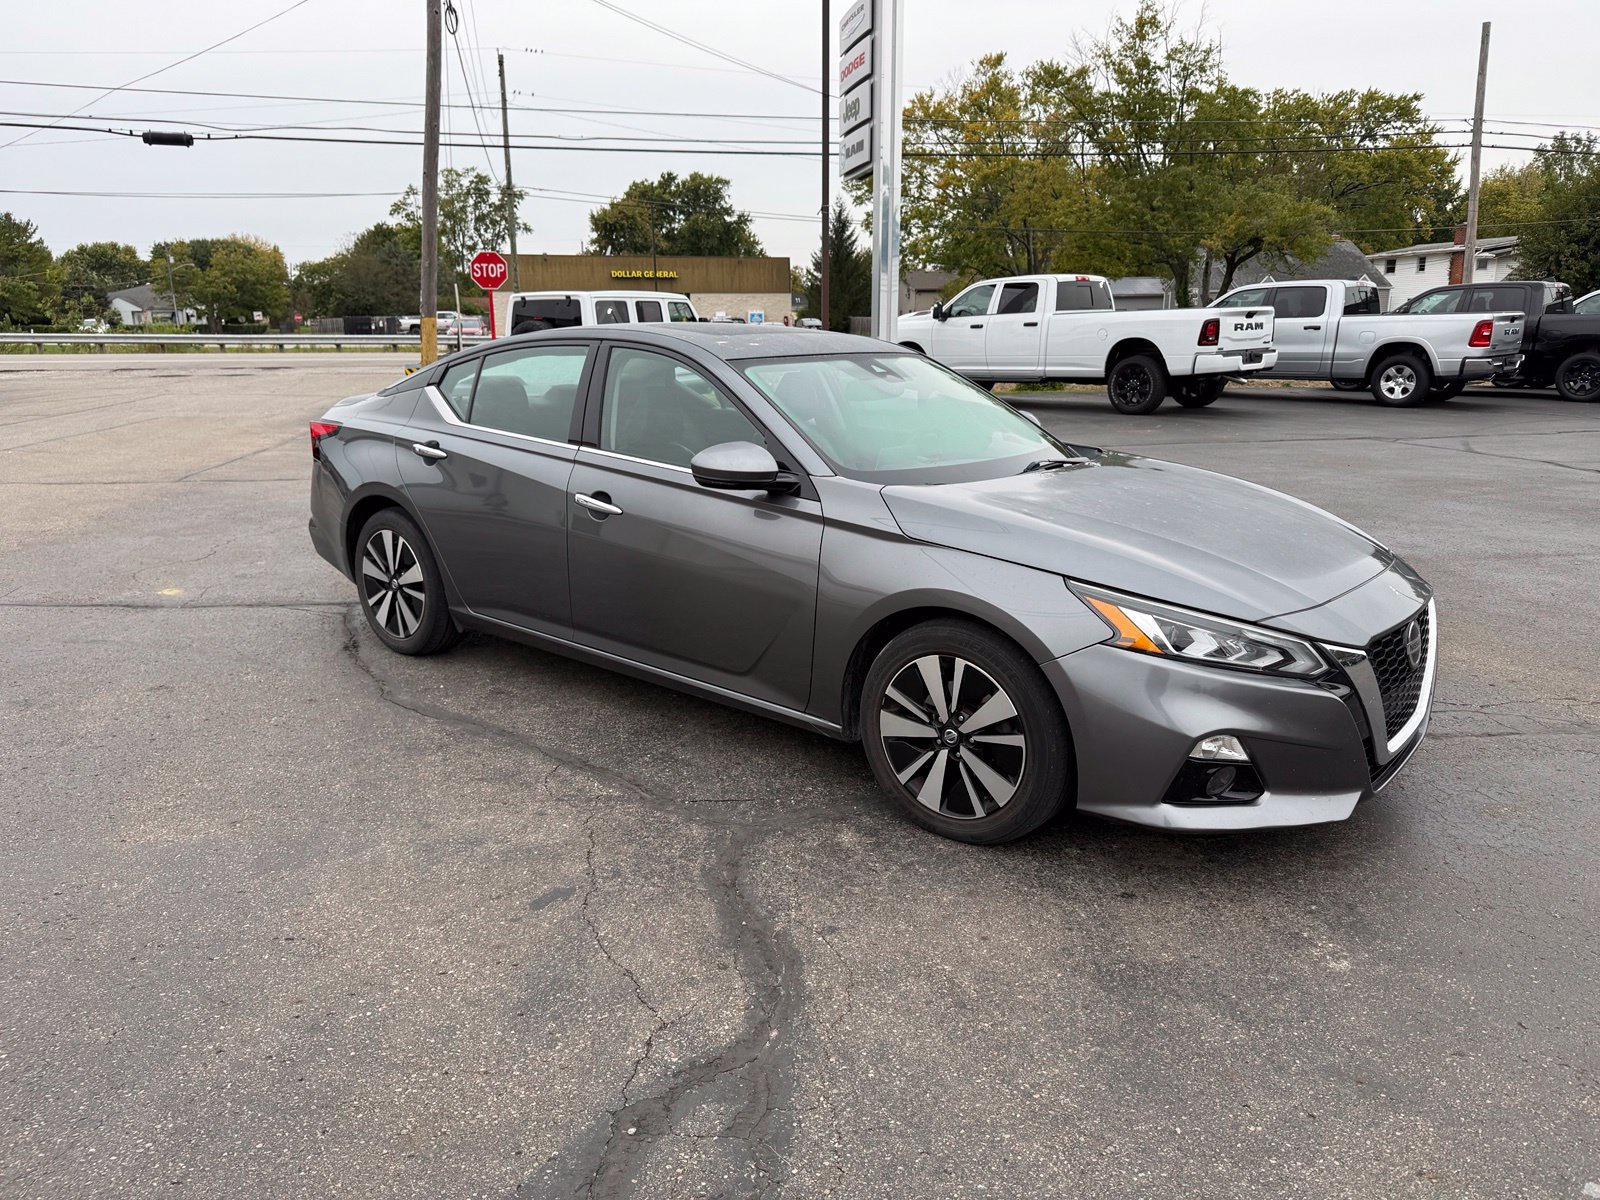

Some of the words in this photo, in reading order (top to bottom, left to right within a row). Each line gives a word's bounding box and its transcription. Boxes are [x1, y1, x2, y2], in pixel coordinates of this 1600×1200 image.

[840, 51, 865, 82] DODGE
[842, 97, 860, 124] Jeep
[845, 139, 864, 159] RAM
[473, 263, 505, 278] STOP
[611, 270, 642, 278] DOLLAR
[1233, 322, 1264, 331] RAM
[1504, 327, 1520, 336] RAM
